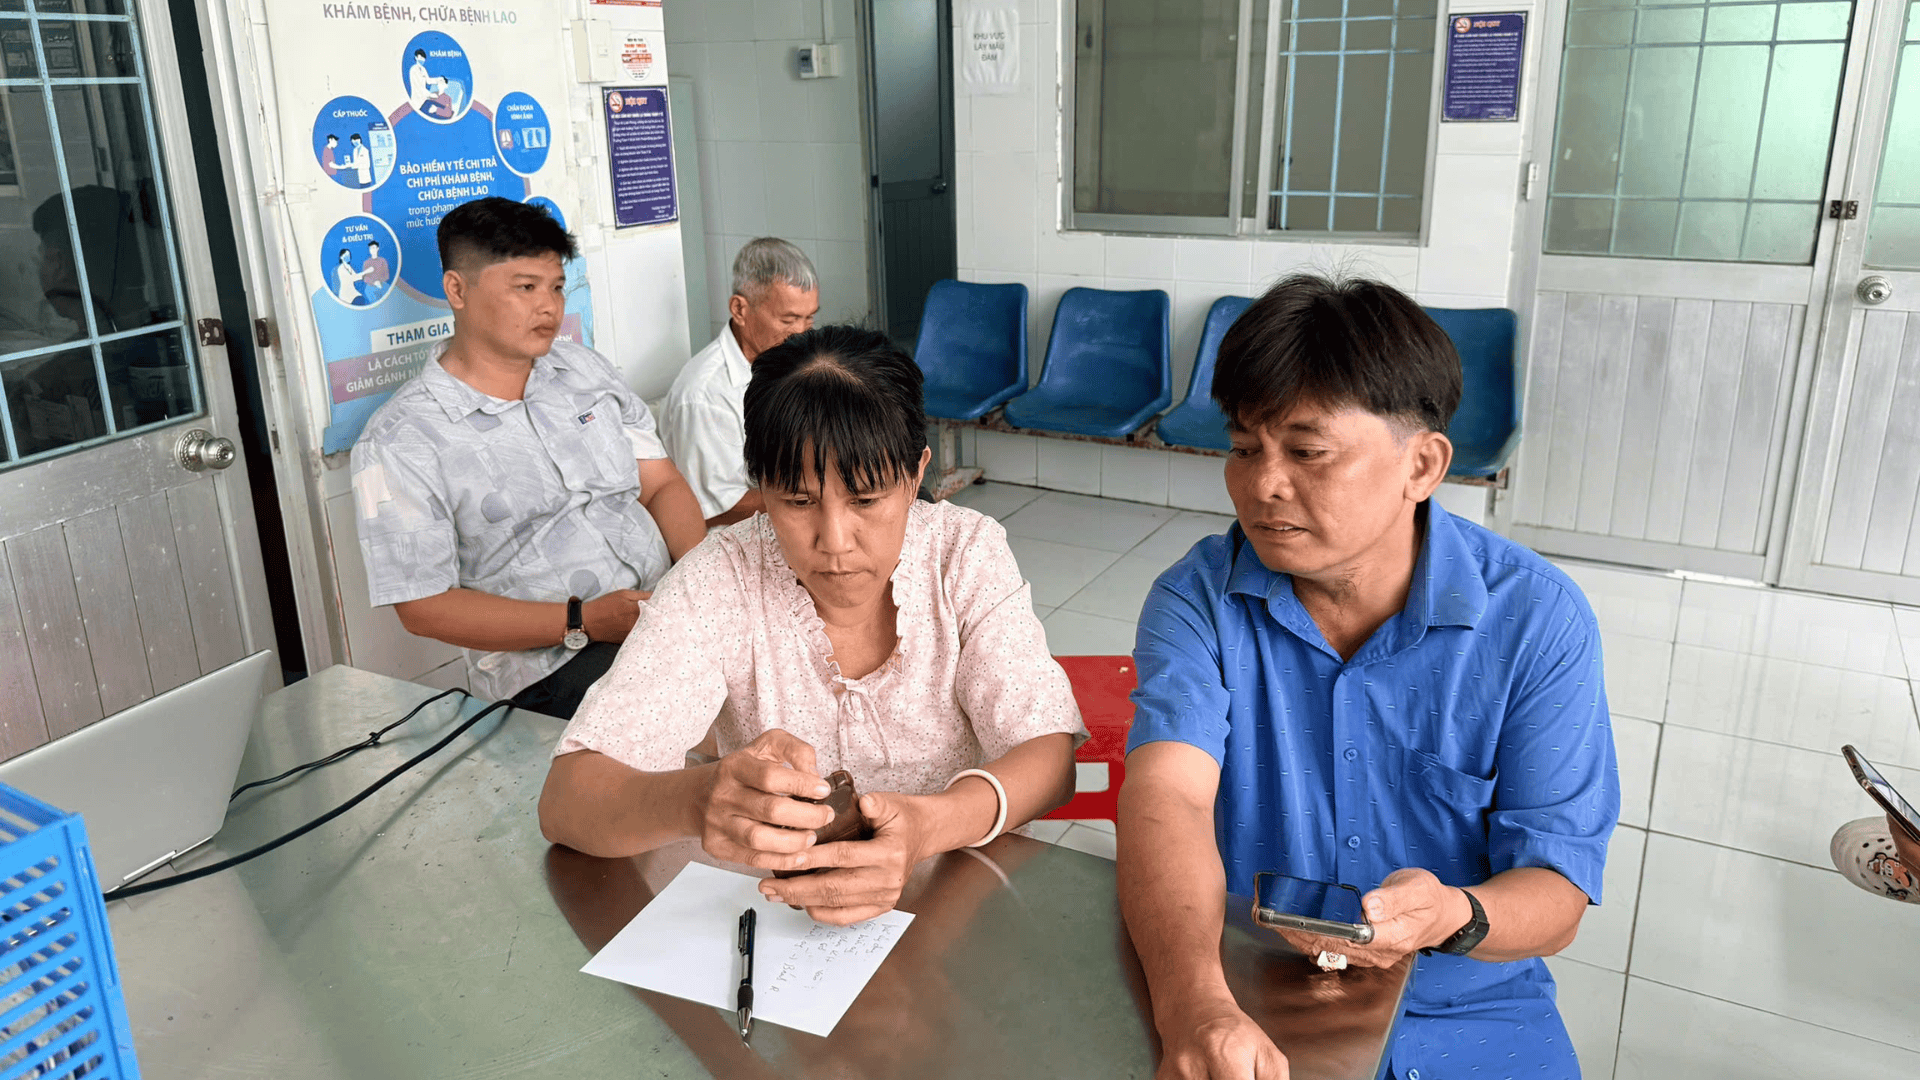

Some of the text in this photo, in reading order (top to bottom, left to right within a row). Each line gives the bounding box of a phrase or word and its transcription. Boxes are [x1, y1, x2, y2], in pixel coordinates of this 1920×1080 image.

[323, 2, 517, 26] KHÁM BỆNH, CHỮA BỆNH LAO
[332, 108, 368, 118] CẤP THUỐC
[400, 155, 497, 174] BẢO HIỂM Y TẾ CHI TRẢ
[407, 171, 495, 188] CHI PHÍ KHÁM BỆNH,
[418, 185, 489, 201] CHỮA BỆNH LAO
[408, 206, 430, 216] trong
[432, 203, 454, 214] phạm
[406, 218, 425, 228] mức
[387, 322, 451, 346] THAM GIA
[368, 348, 429, 372] LÀ CÁCH TỐ
[346, 377, 374, 393] GIẢM
[376, 371, 407, 386] GÁNH
